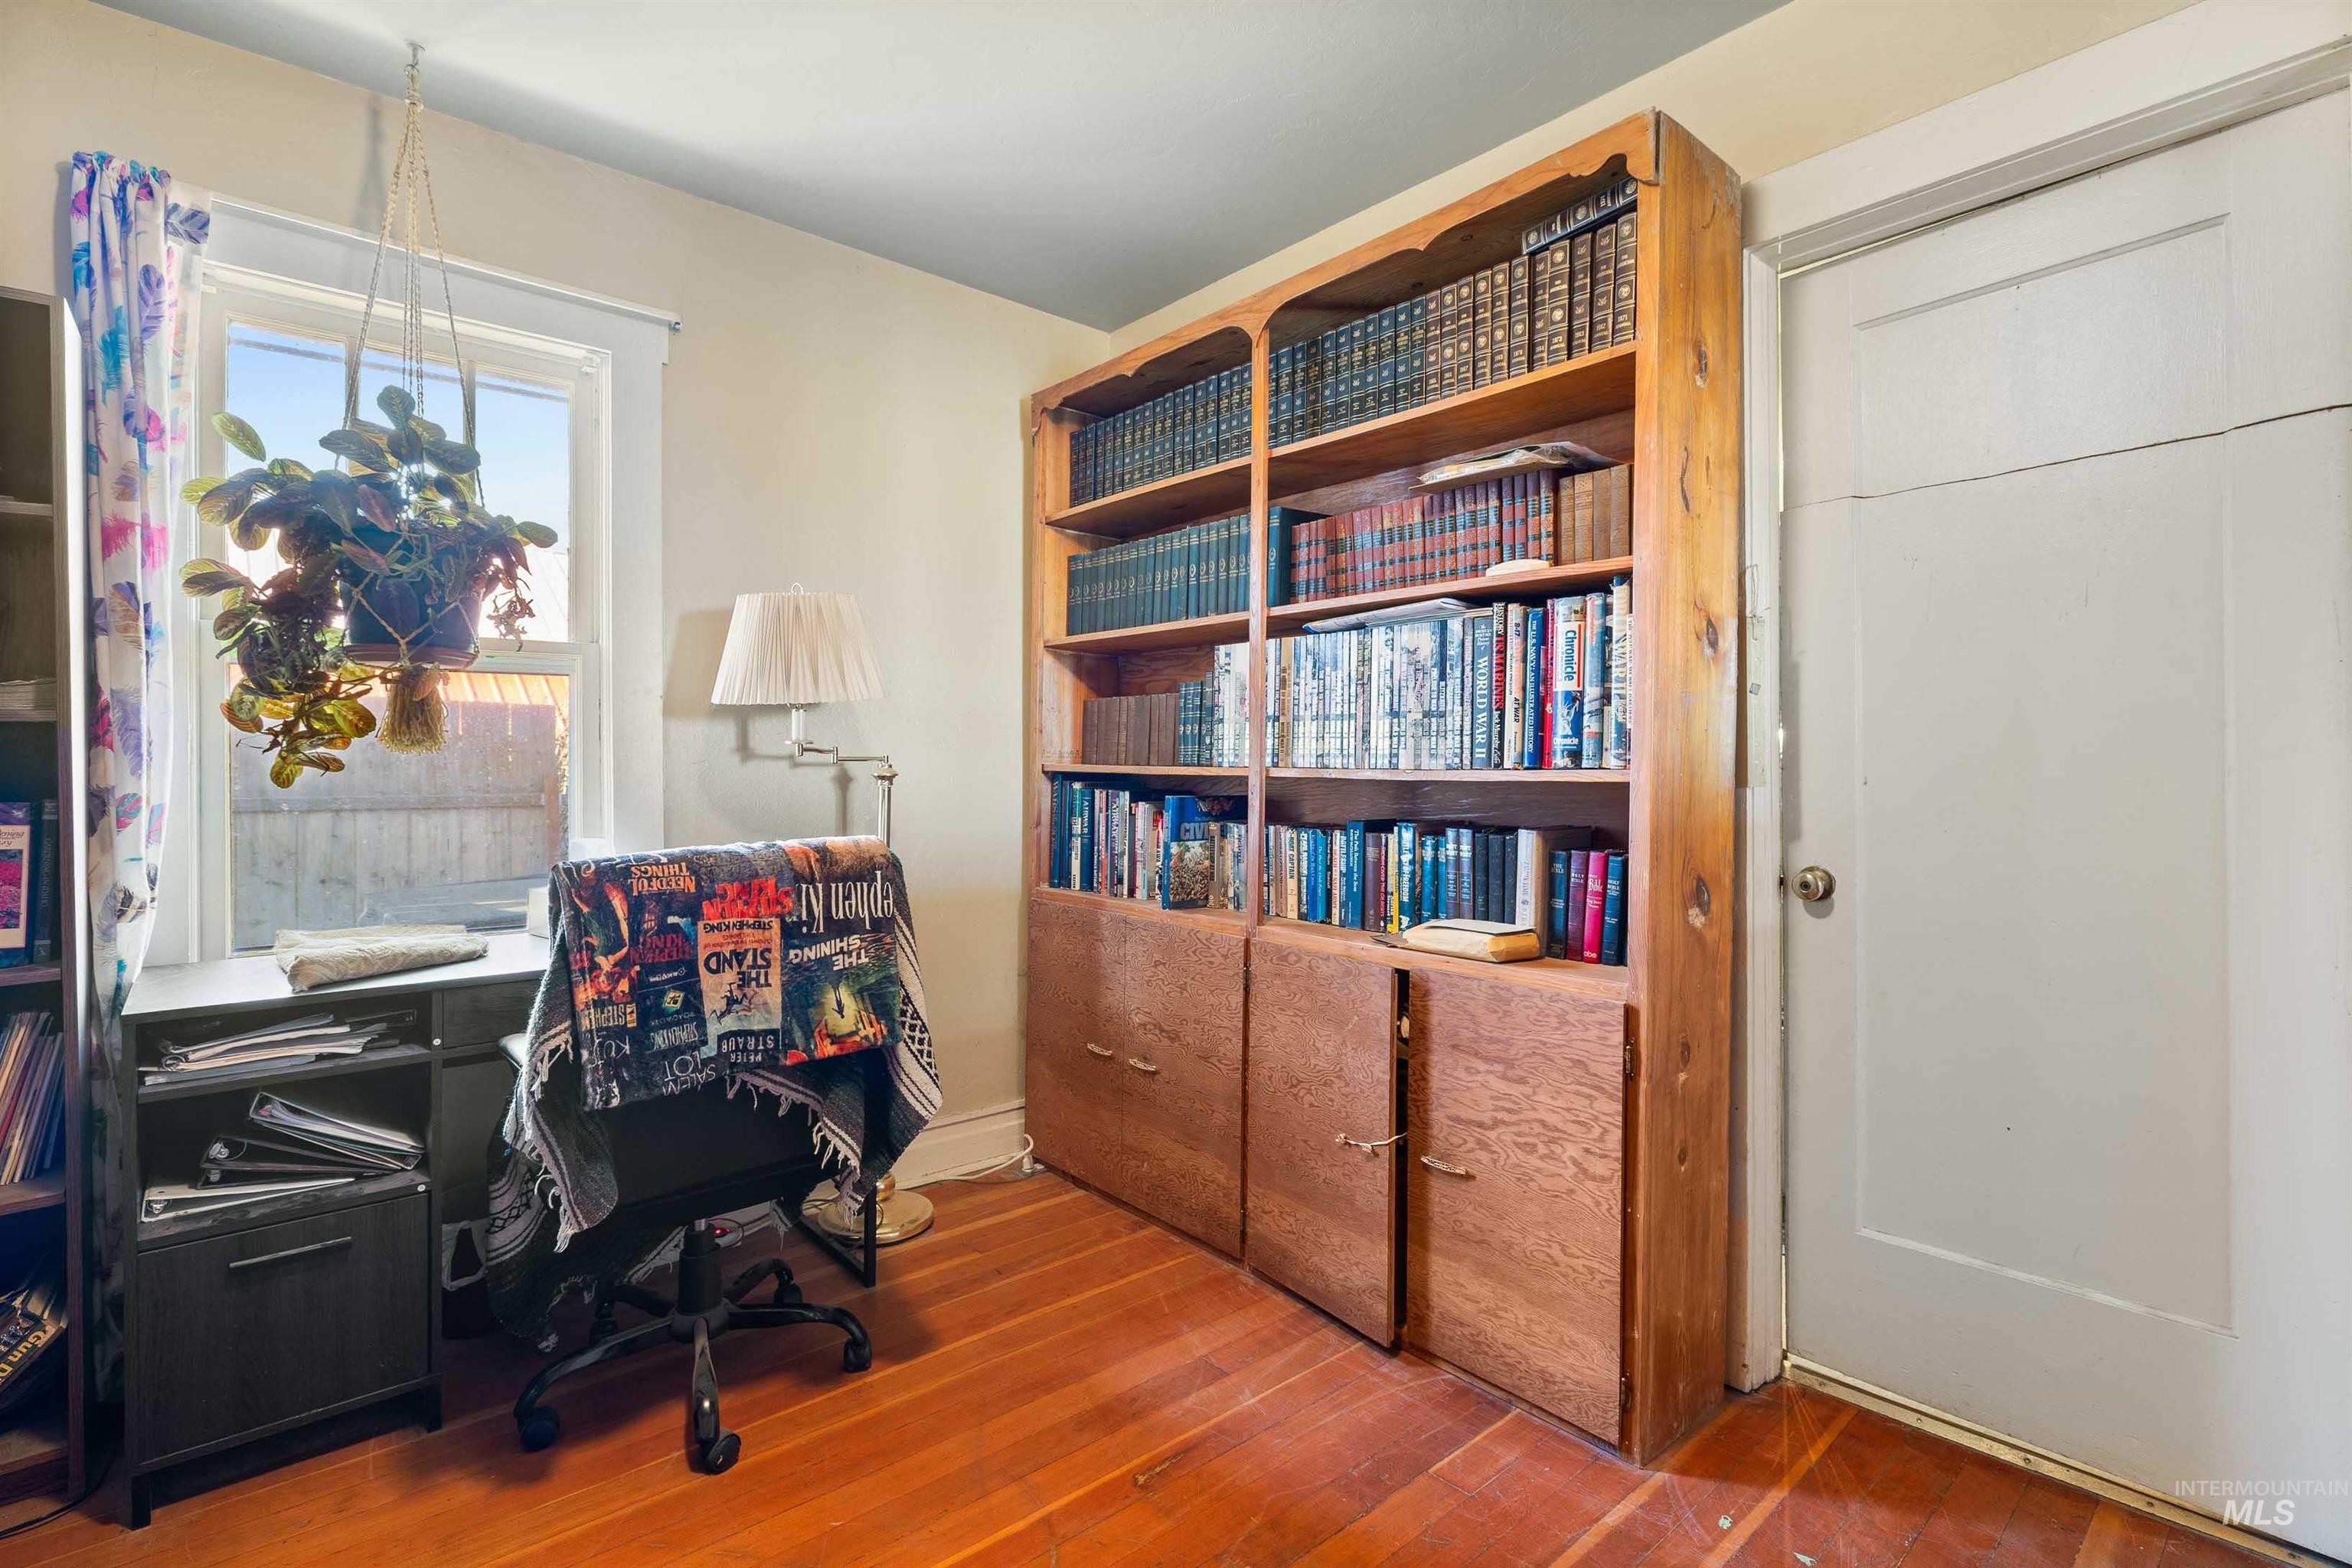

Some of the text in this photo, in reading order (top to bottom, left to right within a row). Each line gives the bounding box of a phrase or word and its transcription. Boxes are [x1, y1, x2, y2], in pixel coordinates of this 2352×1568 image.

[1564, 630, 1577, 681] Chronicle
[1476, 655, 1488, 708] WORLD
[1494, 636, 1506, 709] US MARINES
[1530, 671, 1534, 682] AN
[1514, 697, 1519, 707] AT
[1475, 711, 1487, 743] WAR
[1475, 748, 1486, 758] II
[1181, 822, 1209, 841] CIVI
[631, 862, 690, 877] THINGS
[628, 876, 696, 896] NEEDFUL
[1402, 874, 1410, 902] FREEDOM
[1588, 878, 1603, 892] Bible
[702, 886, 793, 920] STEPHEN
[703, 920, 773, 933] STEPHEN KING
[789, 934, 862, 965] SHINING
[831, 949, 870, 971] THE
[703, 948, 772, 975] STAND
[737, 971, 772, 989] THE
[721, 1035, 775, 1052] STRAUB
[665, 1050, 701, 1081] LOT
[729, 1052, 762, 1063] PETER
[7, 1331, 46, 1362] Gun
